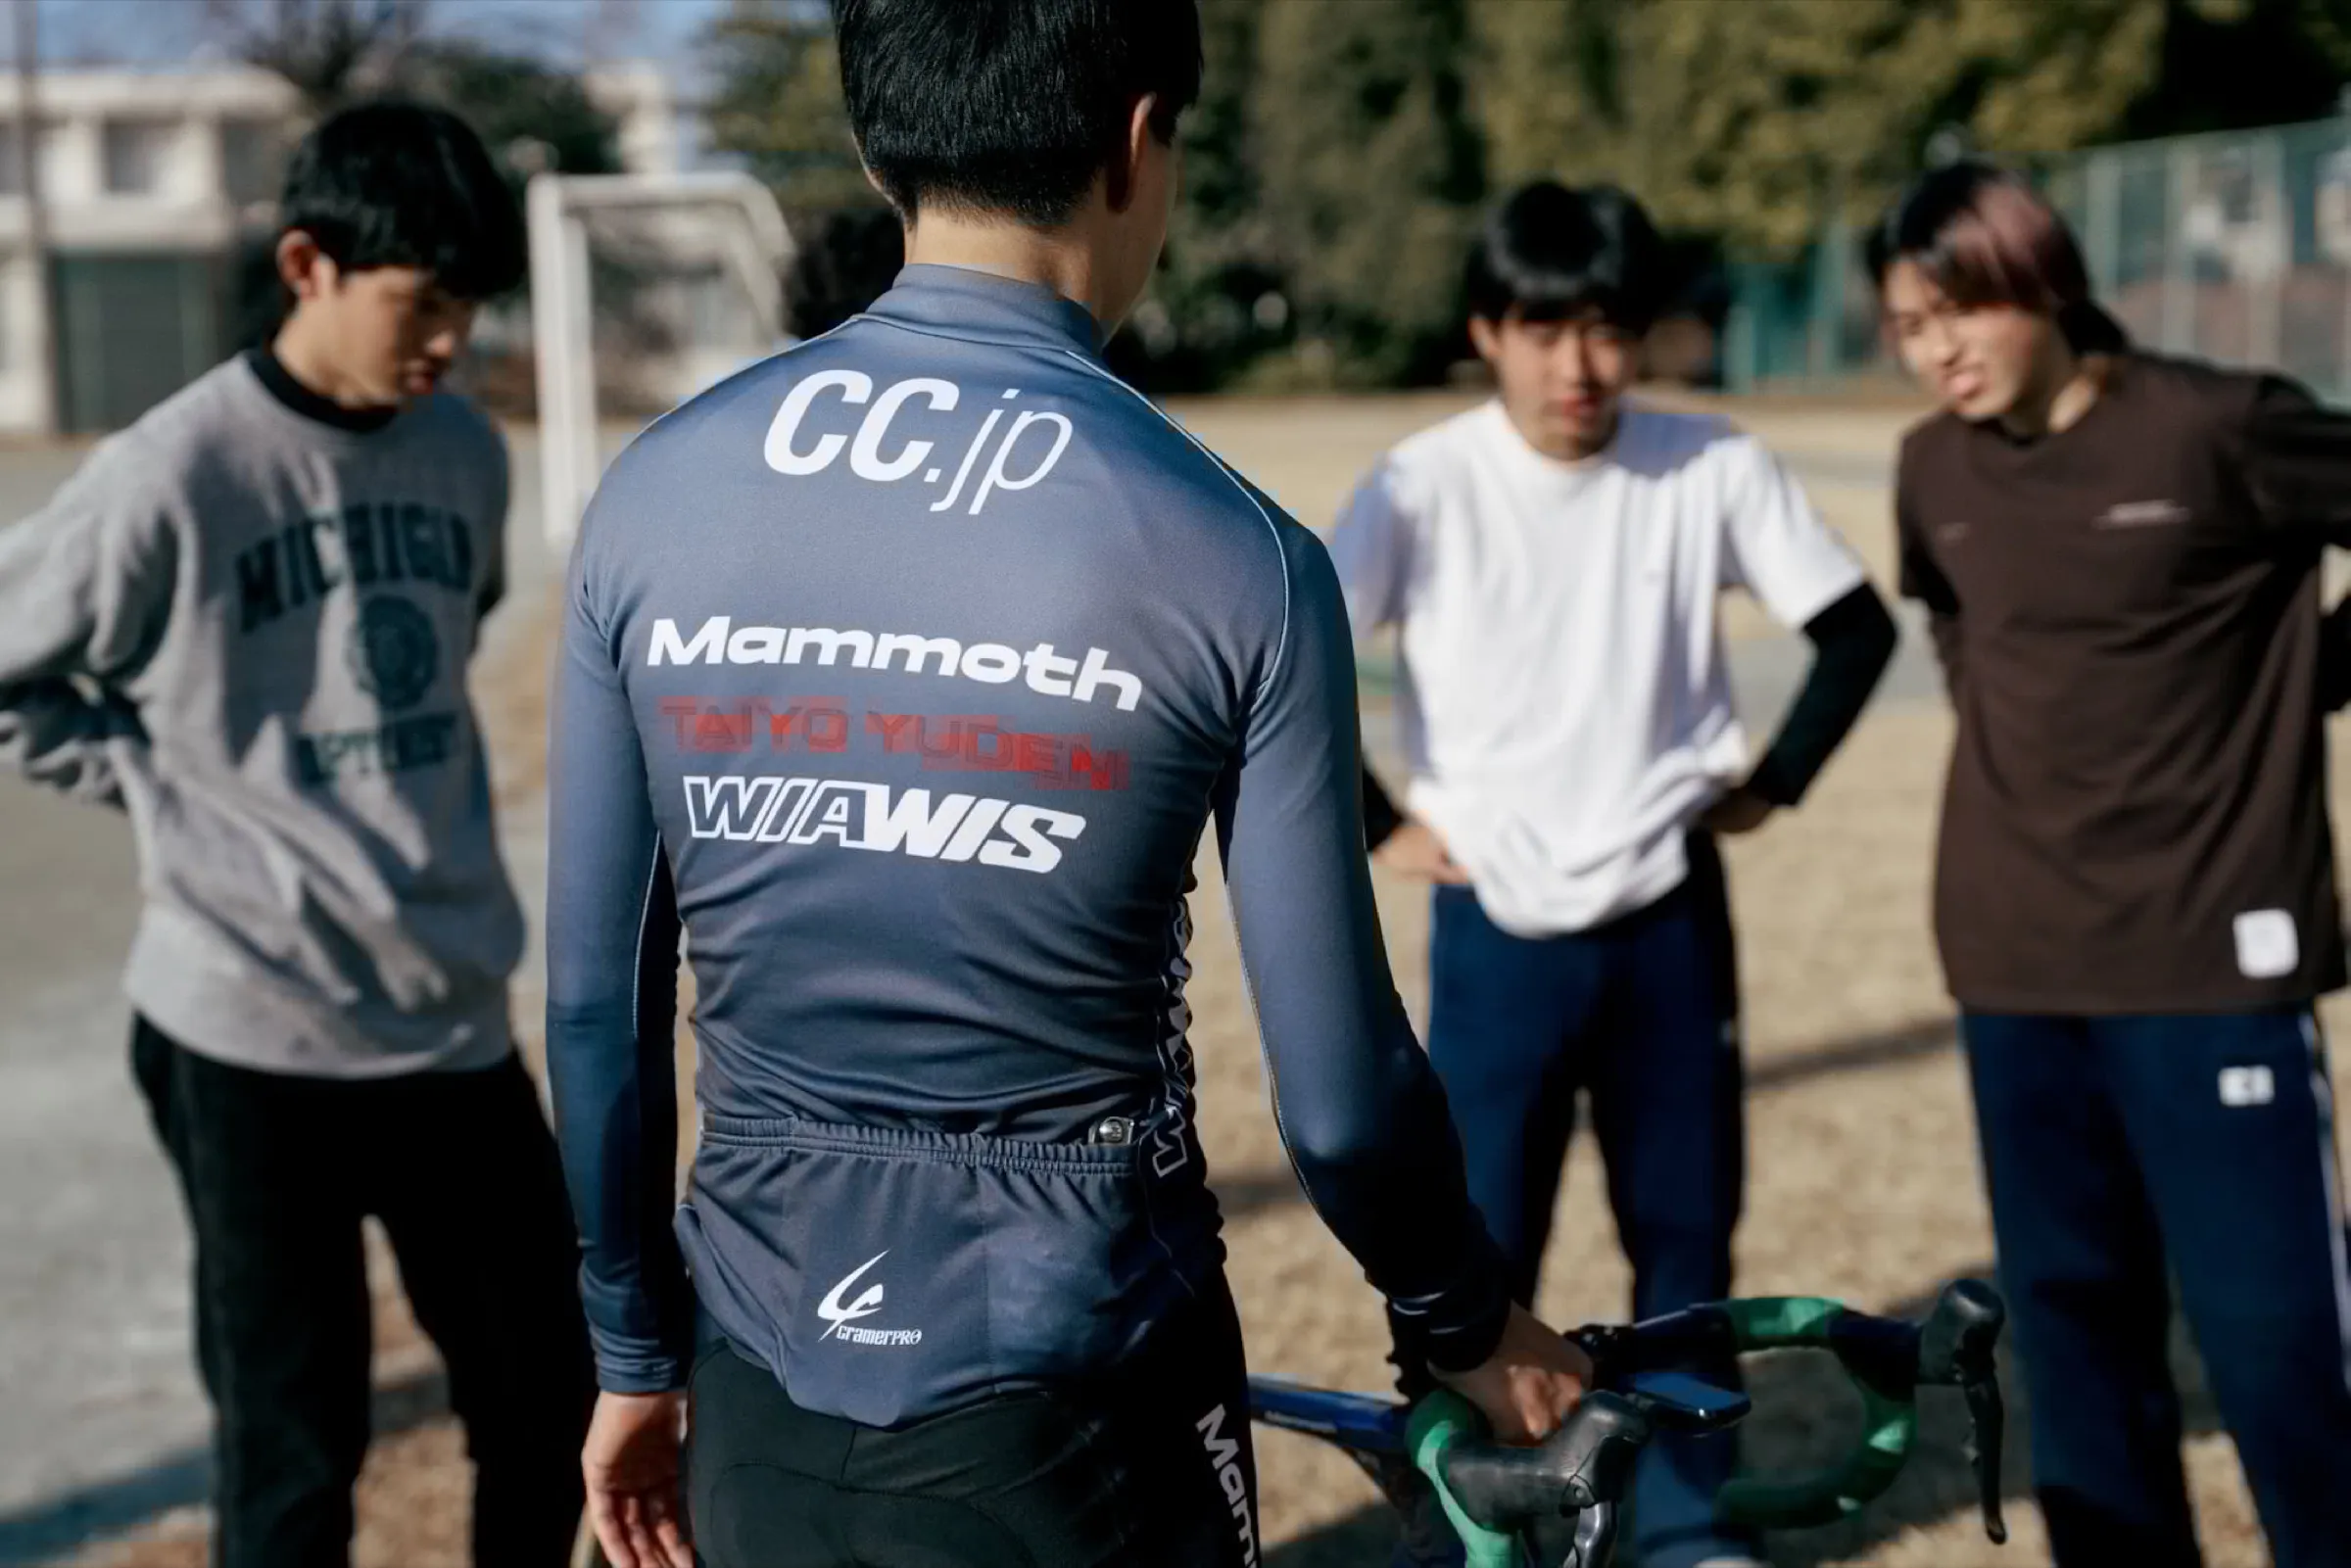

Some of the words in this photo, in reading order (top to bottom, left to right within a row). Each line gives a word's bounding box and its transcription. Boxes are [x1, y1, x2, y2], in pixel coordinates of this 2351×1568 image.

[764, 369, 1073, 515] CC.jp
[647, 616, 1142, 712] Mammoth
[660, 702, 849, 750] TAIYO
[866, 709, 1128, 788] YUDEN
[683, 776, 1086, 874] WIAWIS
[1195, 1403, 1258, 1568] Mam
